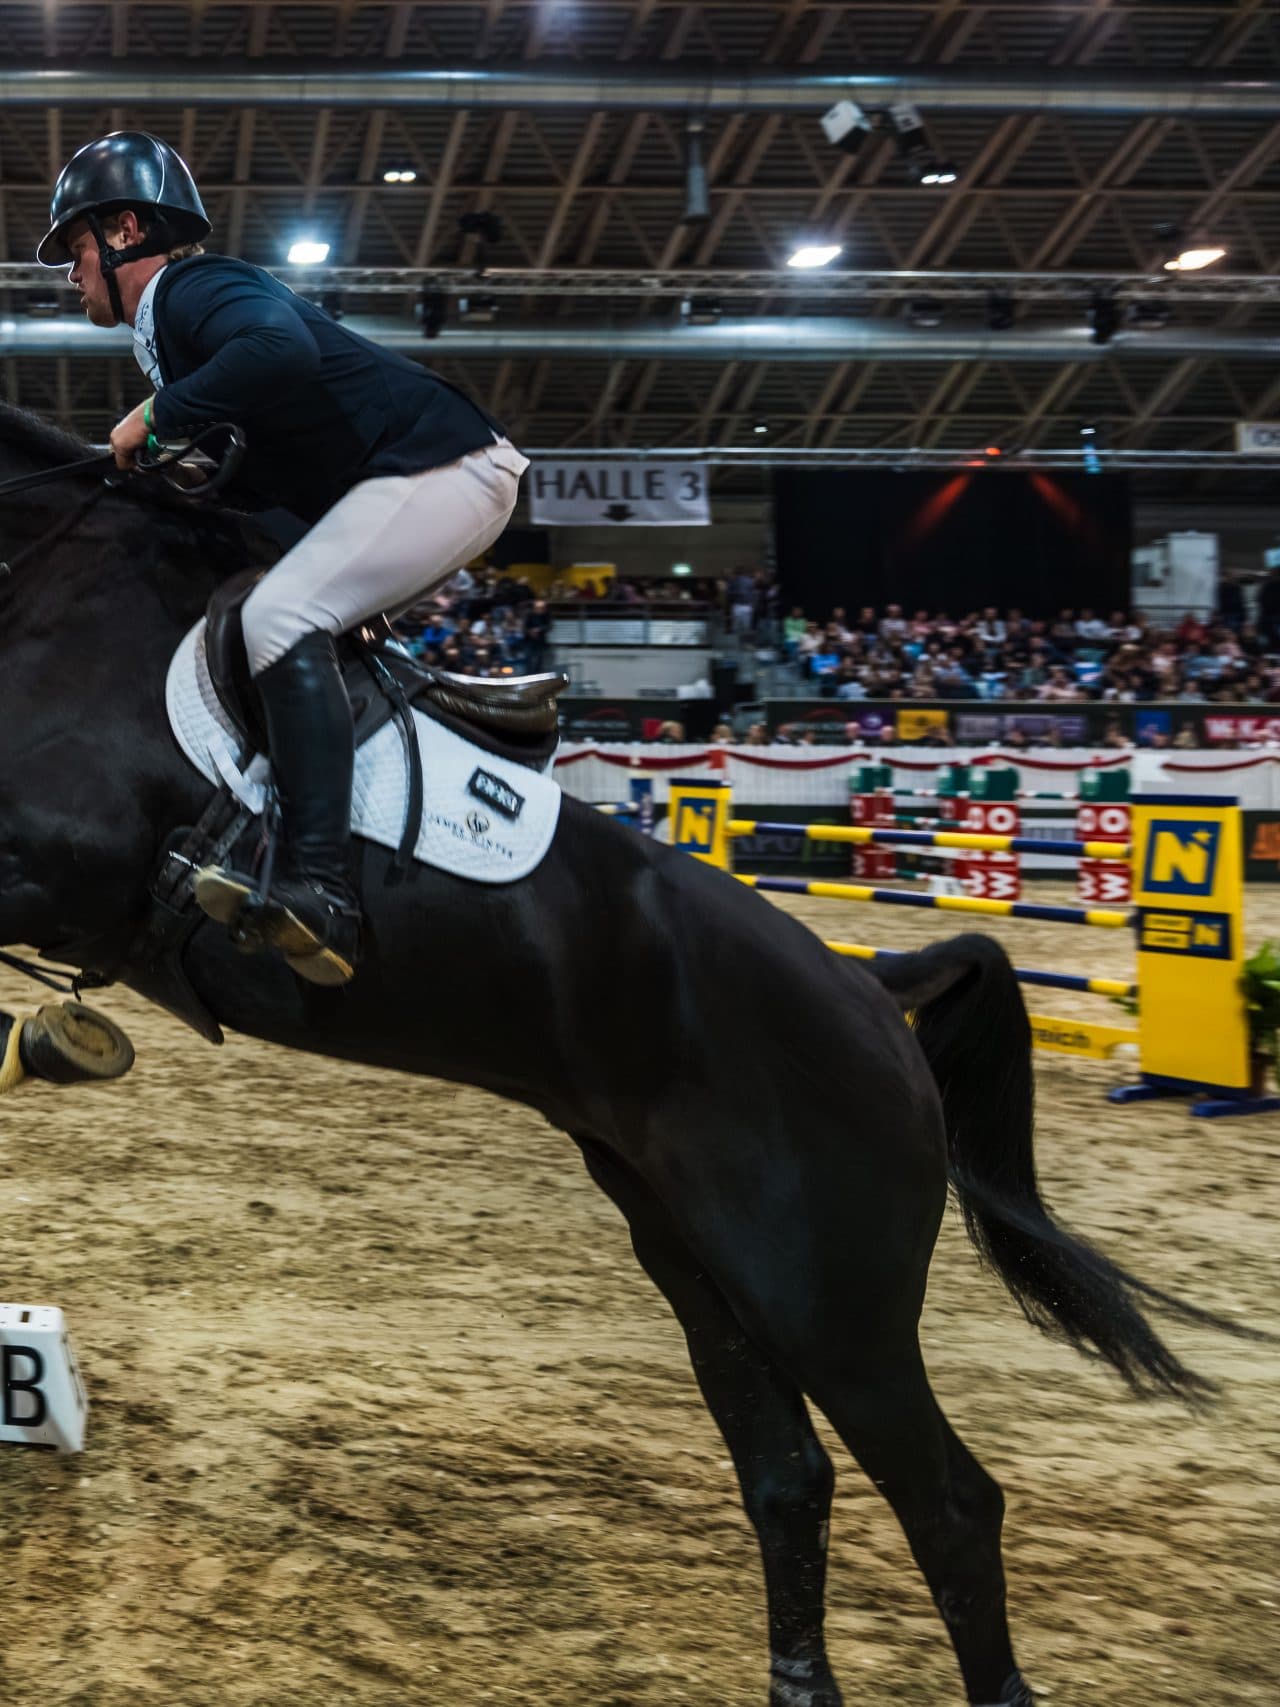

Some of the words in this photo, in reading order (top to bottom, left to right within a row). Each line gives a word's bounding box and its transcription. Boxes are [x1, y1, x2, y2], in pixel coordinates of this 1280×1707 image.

[534, 468, 664, 499] HALLE
[680, 471, 701, 500] 3
[1, 1345, 47, 1427] B
